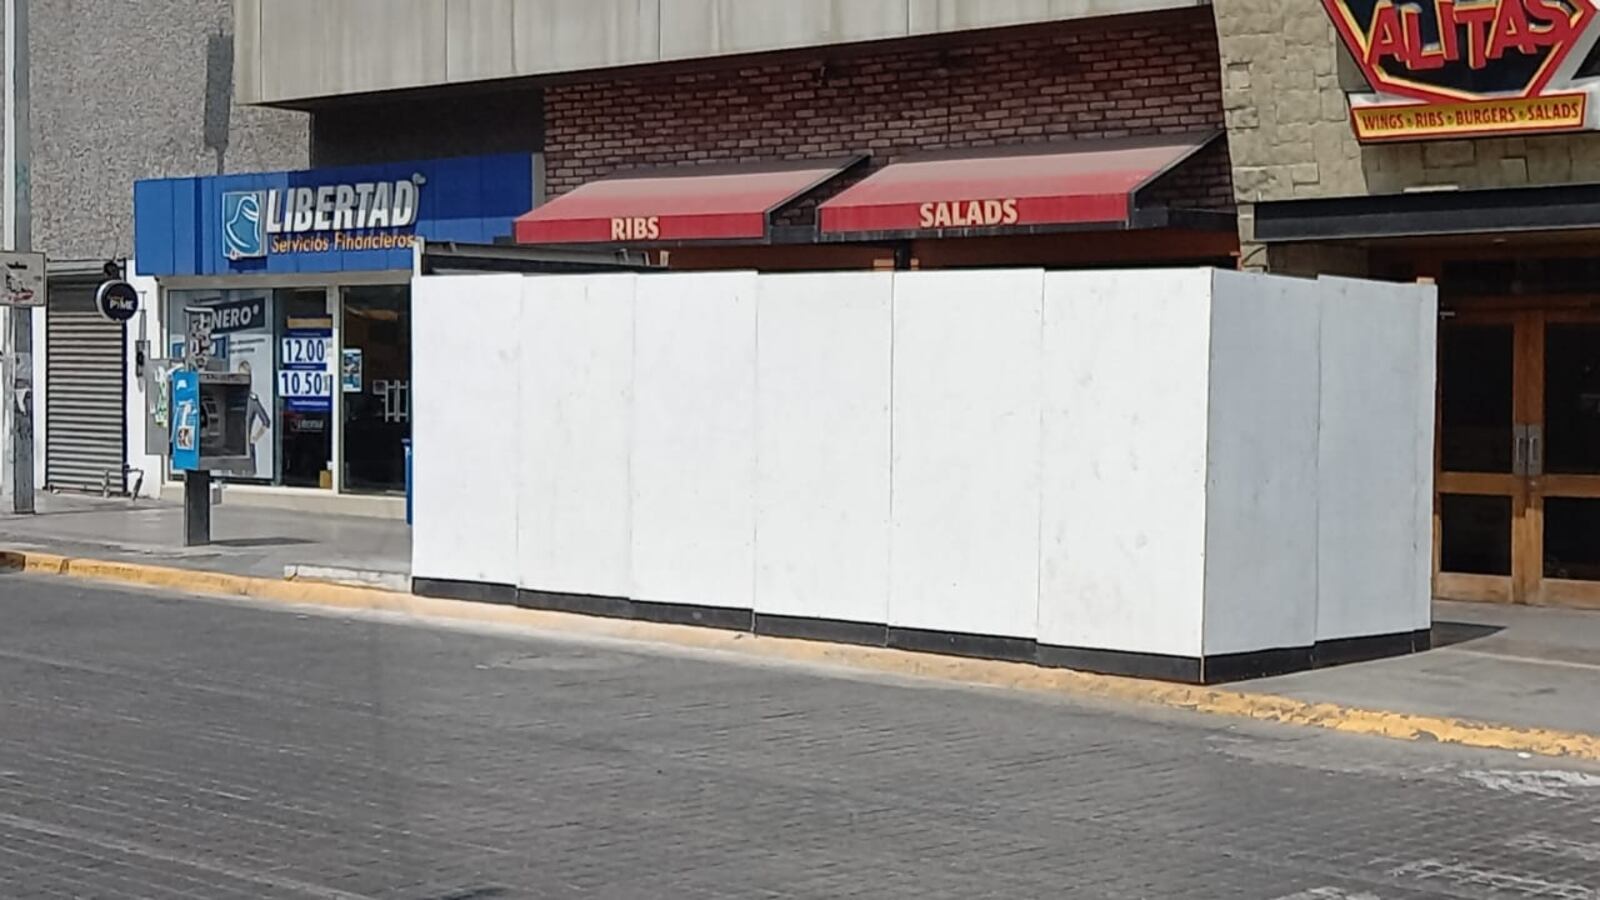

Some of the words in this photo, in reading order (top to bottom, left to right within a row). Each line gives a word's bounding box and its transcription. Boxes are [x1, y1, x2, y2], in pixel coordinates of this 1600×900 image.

[1365, 0, 1573, 71] ALITAS
[1362, 111, 1404, 131] WINGS
[1415, 109, 1445, 128] RIBS
[1455, 106, 1517, 127] BURGERS
[1526, 102, 1580, 121] SALADS
[265, 179, 419, 234] LIBERTAD
[918, 198, 1019, 229] SALADS
[610, 215, 661, 241] RIBS
[271, 234, 329, 254] Servicios
[333, 231, 416, 250] Financieros
[285, 338, 325, 363] 12.00
[281, 372, 323, 395] 10.50
